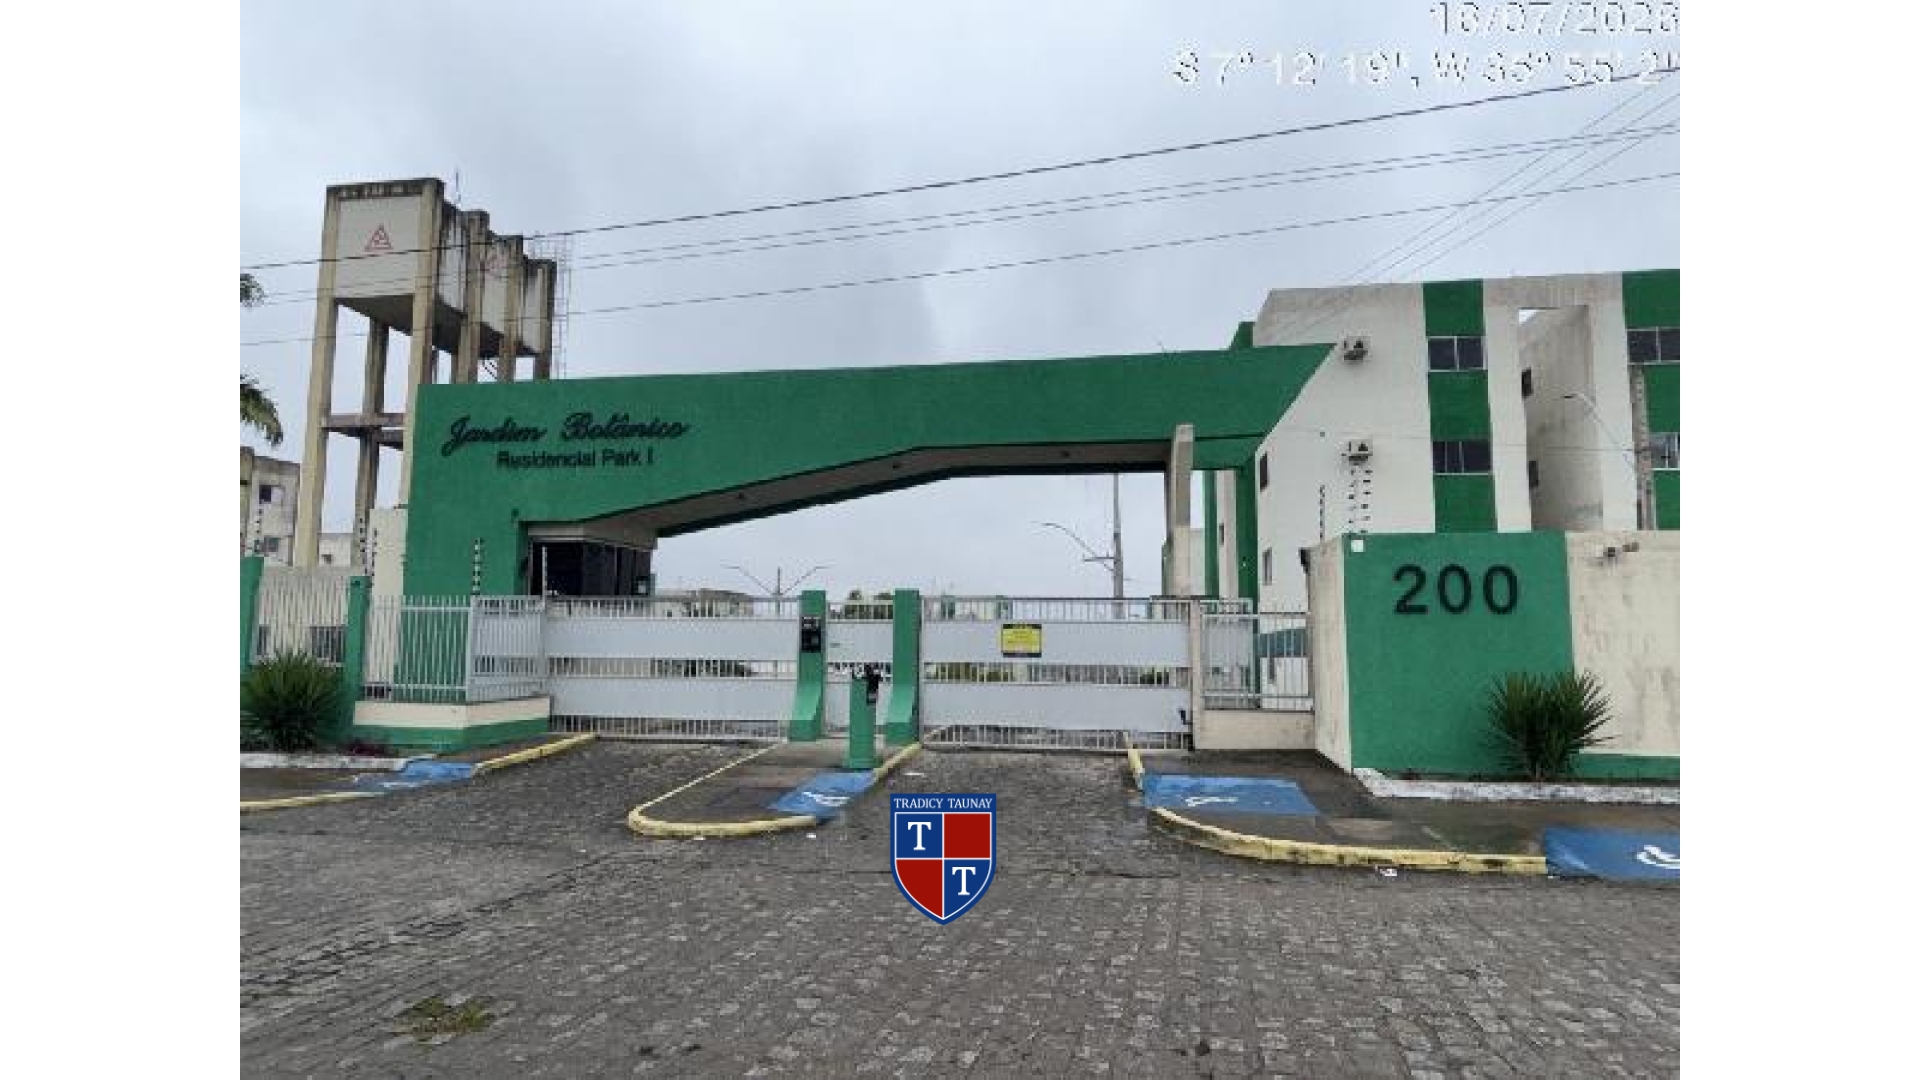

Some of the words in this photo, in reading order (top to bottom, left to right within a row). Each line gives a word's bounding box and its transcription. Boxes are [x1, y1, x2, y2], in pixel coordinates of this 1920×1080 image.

[441, 414, 547, 456] Jardim
[561, 412, 691, 440] Botânico
[496, 450, 595, 468] Residencial
[602, 448, 642, 466] Park
[1394, 563, 1518, 614] 200
